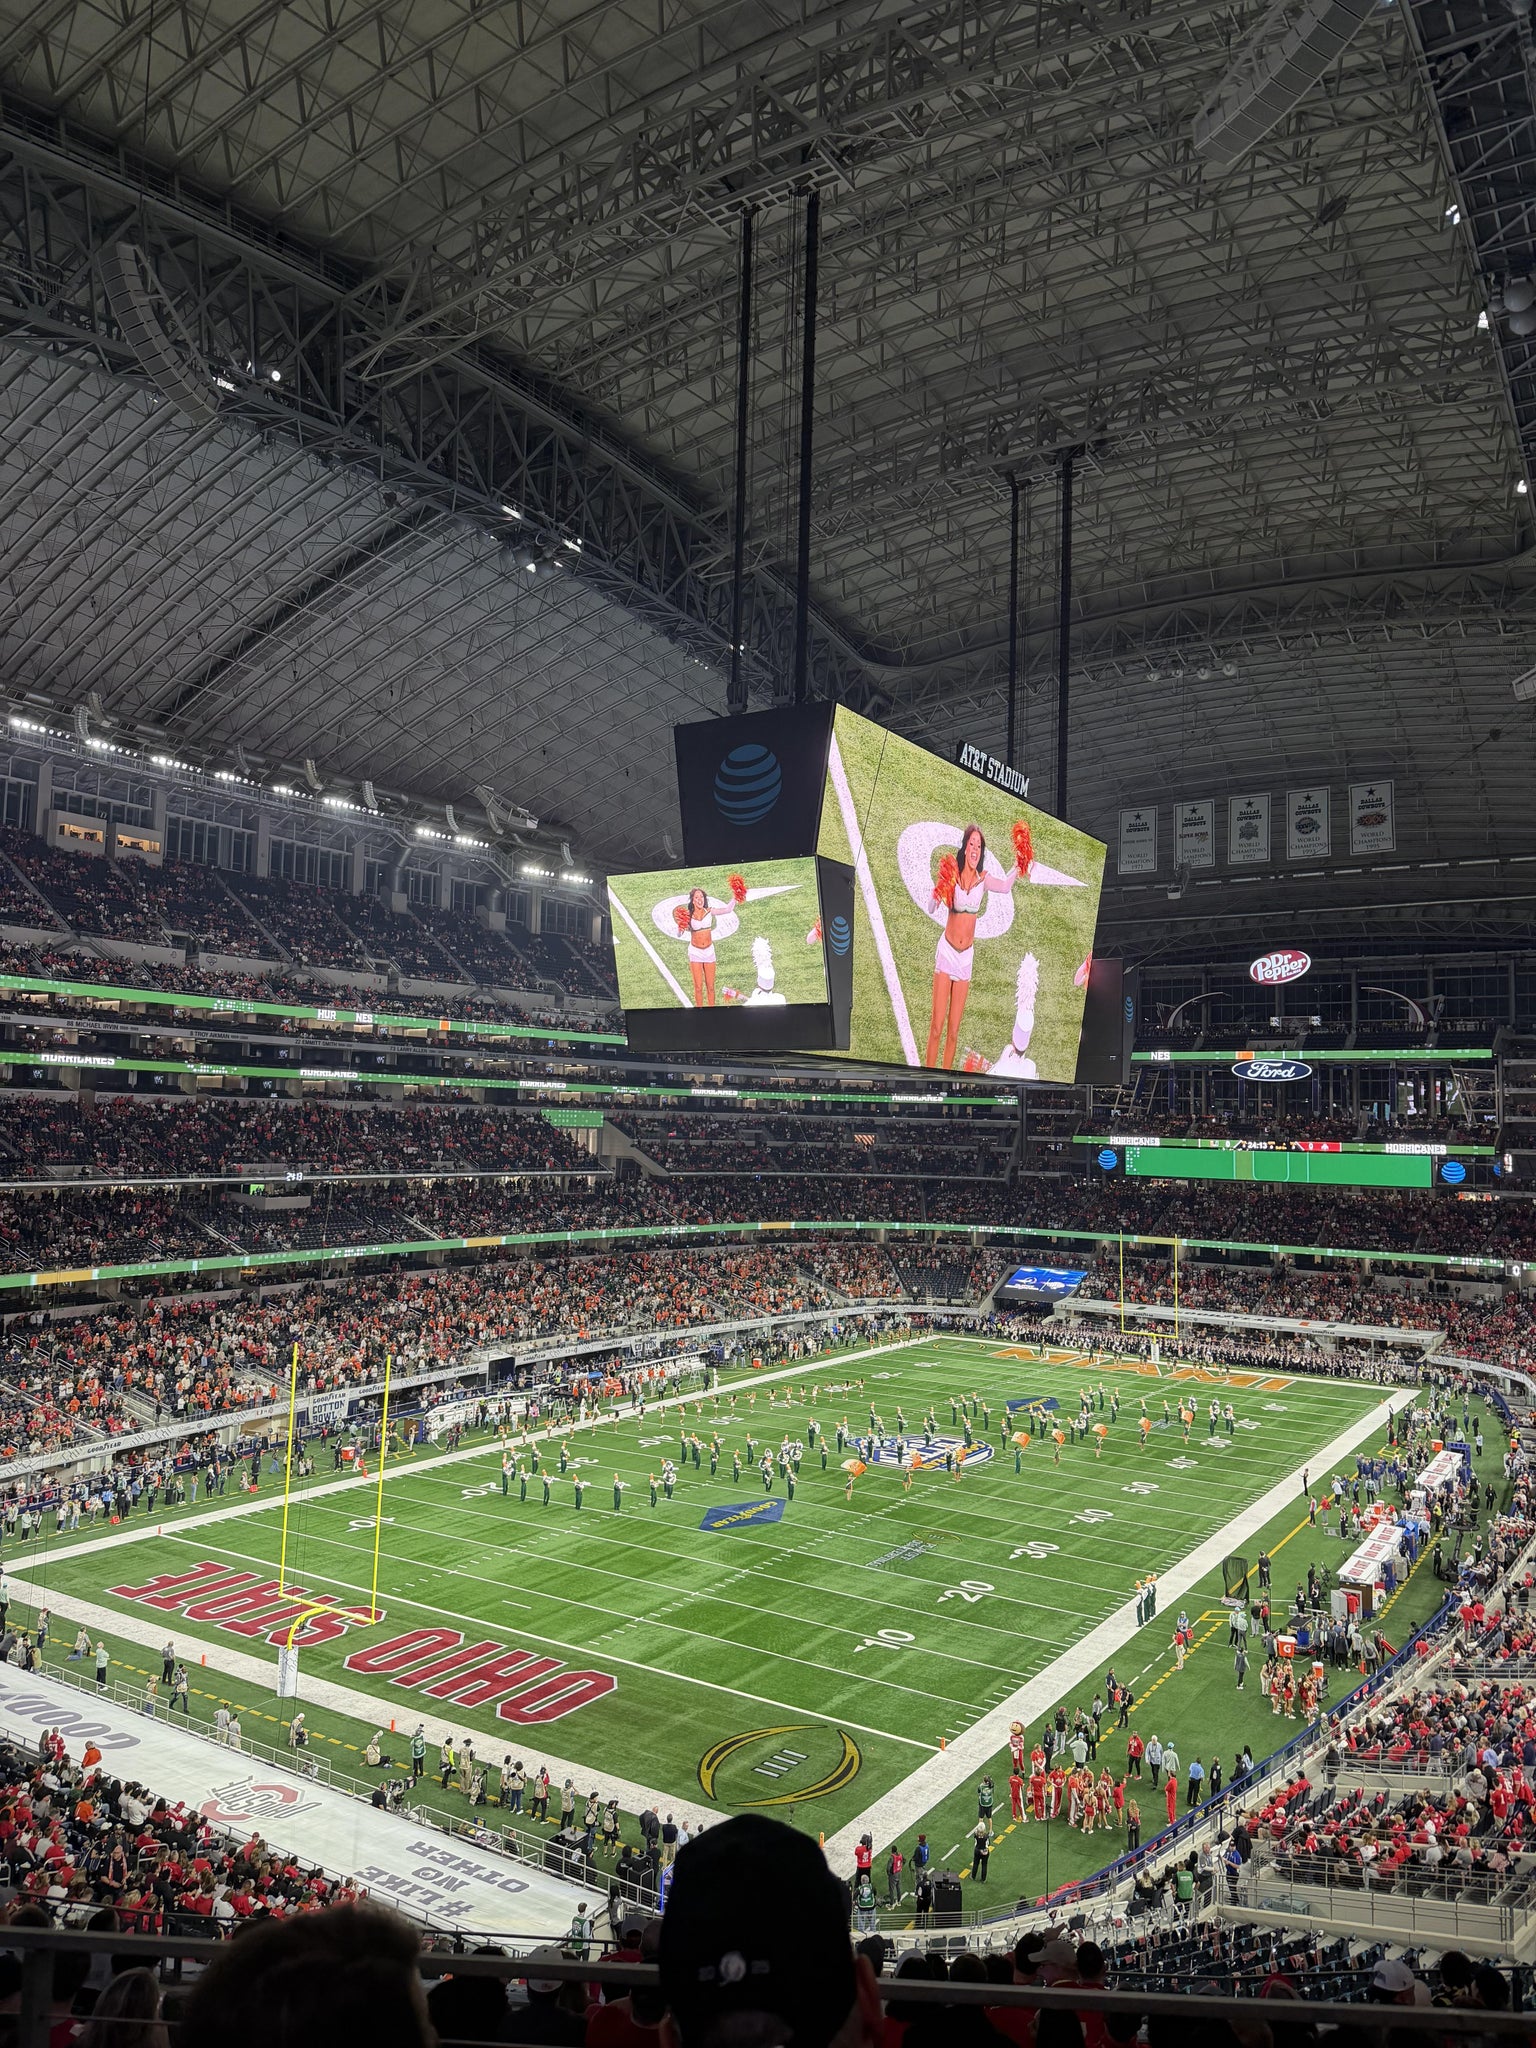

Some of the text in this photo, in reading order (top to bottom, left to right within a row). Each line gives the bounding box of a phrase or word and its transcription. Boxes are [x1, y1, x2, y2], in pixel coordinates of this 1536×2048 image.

[960, 743, 1030, 798] AT&T STADIUM
[1358, 802, 1385, 810] COWBOYS
[1271, 953, 1292, 968] Dr
[1257, 958, 1306, 982] Pepper
[317, 1008, 373, 1023] HUR NES
[75, 1021, 101, 1029] MICHAEL
[102, 1022, 119, 1030] IRVIN
[1150, 1052, 1171, 1061] NES
[1247, 1061, 1296, 1079] Ford
[1247, 1141, 1268, 1150] 24:13
[312, 1400, 346, 1414] COTTON
[312, 1411, 338, 1423] BOWL
[87, 1441, 122, 1454] GOODYEAR
[1121, 1481, 1160, 1495] 50
[709, 1501, 779, 1529] GOODYEAR
[1074, 1508, 1114, 1524] 40
[1013, 1541, 1060, 1559] 30
[943, 1580, 995, 1603] 20
[103, 1560, 618, 1725] OHIO STATE
[863, 1628, 915, 1650] 10
[1282, 1644, 1292, 1654] G
[405, 1840, 530, 1893] OTHER
[411, 1866, 471, 1893] NO
[352, 1865, 477, 1918] #LIKE
